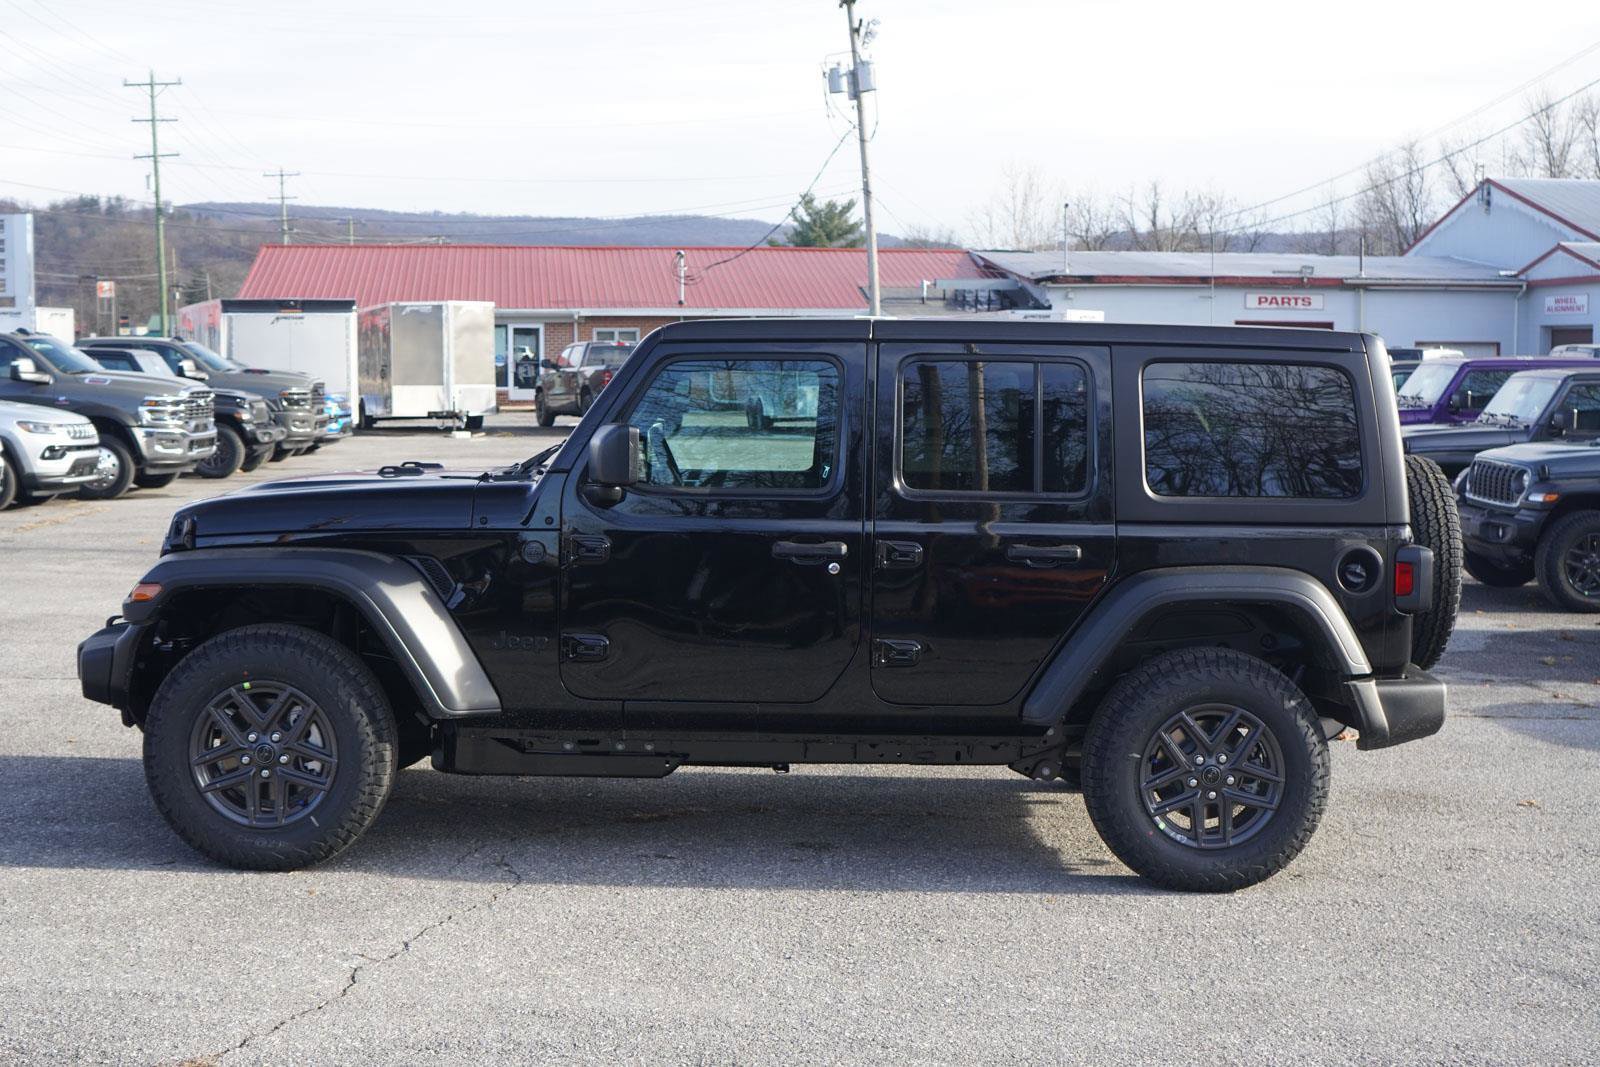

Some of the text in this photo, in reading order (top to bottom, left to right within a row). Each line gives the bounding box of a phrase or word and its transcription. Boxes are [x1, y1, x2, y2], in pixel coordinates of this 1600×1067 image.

[1257, 295, 1313, 308] PARTS
[1546, 304, 1585, 313] ALIGNMENT
[491, 630, 549, 654] Jeep
